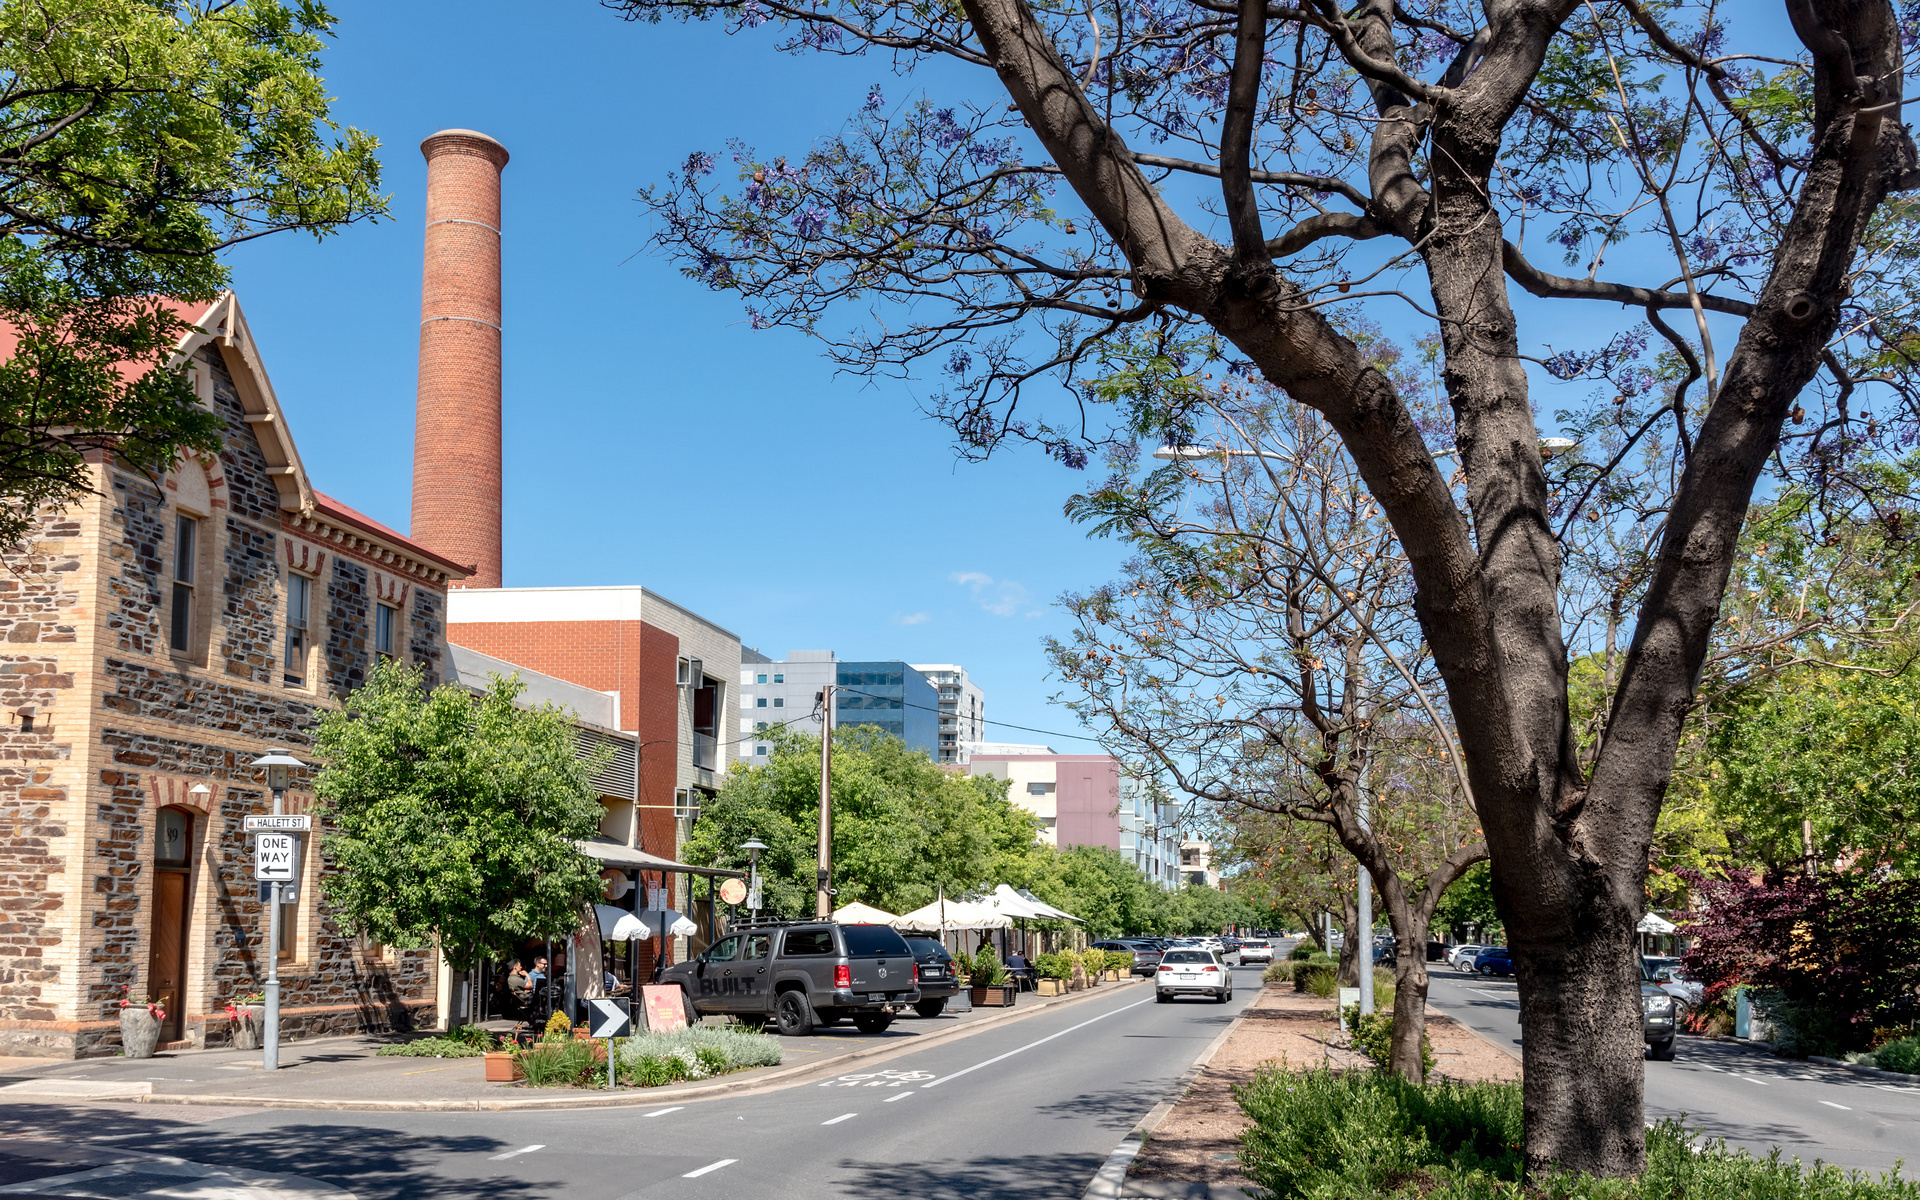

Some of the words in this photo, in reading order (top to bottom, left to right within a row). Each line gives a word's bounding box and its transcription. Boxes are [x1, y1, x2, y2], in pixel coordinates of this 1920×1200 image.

[257, 818, 290, 827] HALLETT
[292, 818, 302, 827] ST
[262, 837, 288, 849] ONE
[260, 852, 290, 863] WAY
[700, 977, 761, 997] BUILT.
